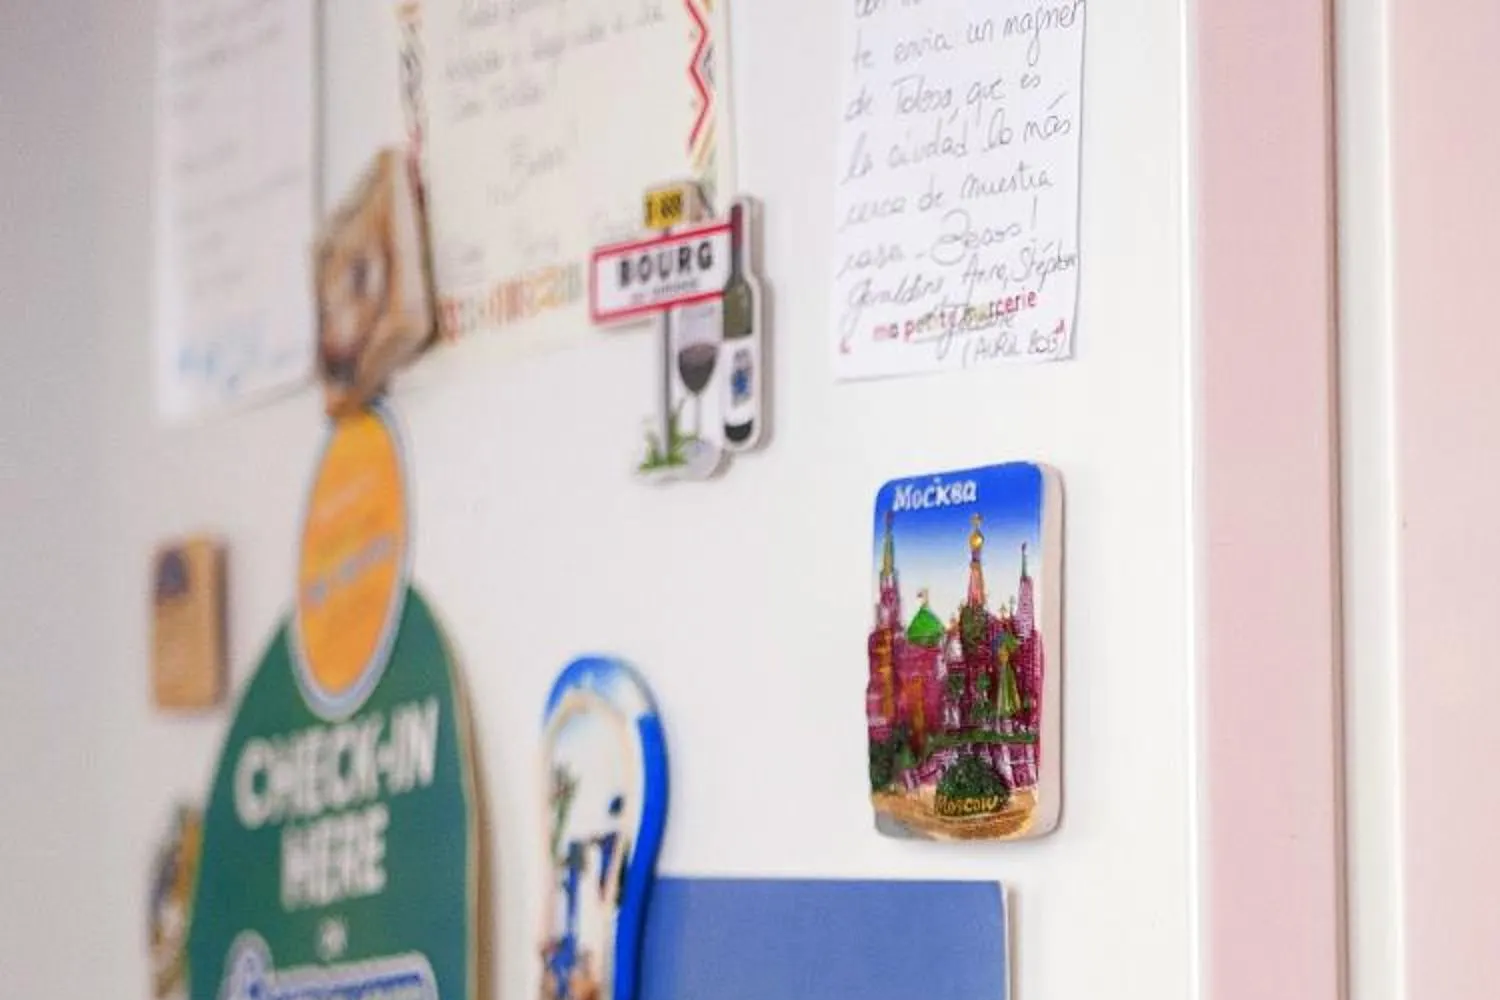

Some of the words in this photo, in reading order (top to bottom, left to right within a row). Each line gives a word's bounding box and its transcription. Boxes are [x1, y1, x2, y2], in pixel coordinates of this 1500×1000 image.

[619, 241, 713, 287] BOURG
[233, 697, 440, 828] CHECK-IN
[281, 804, 390, 910] HERE
